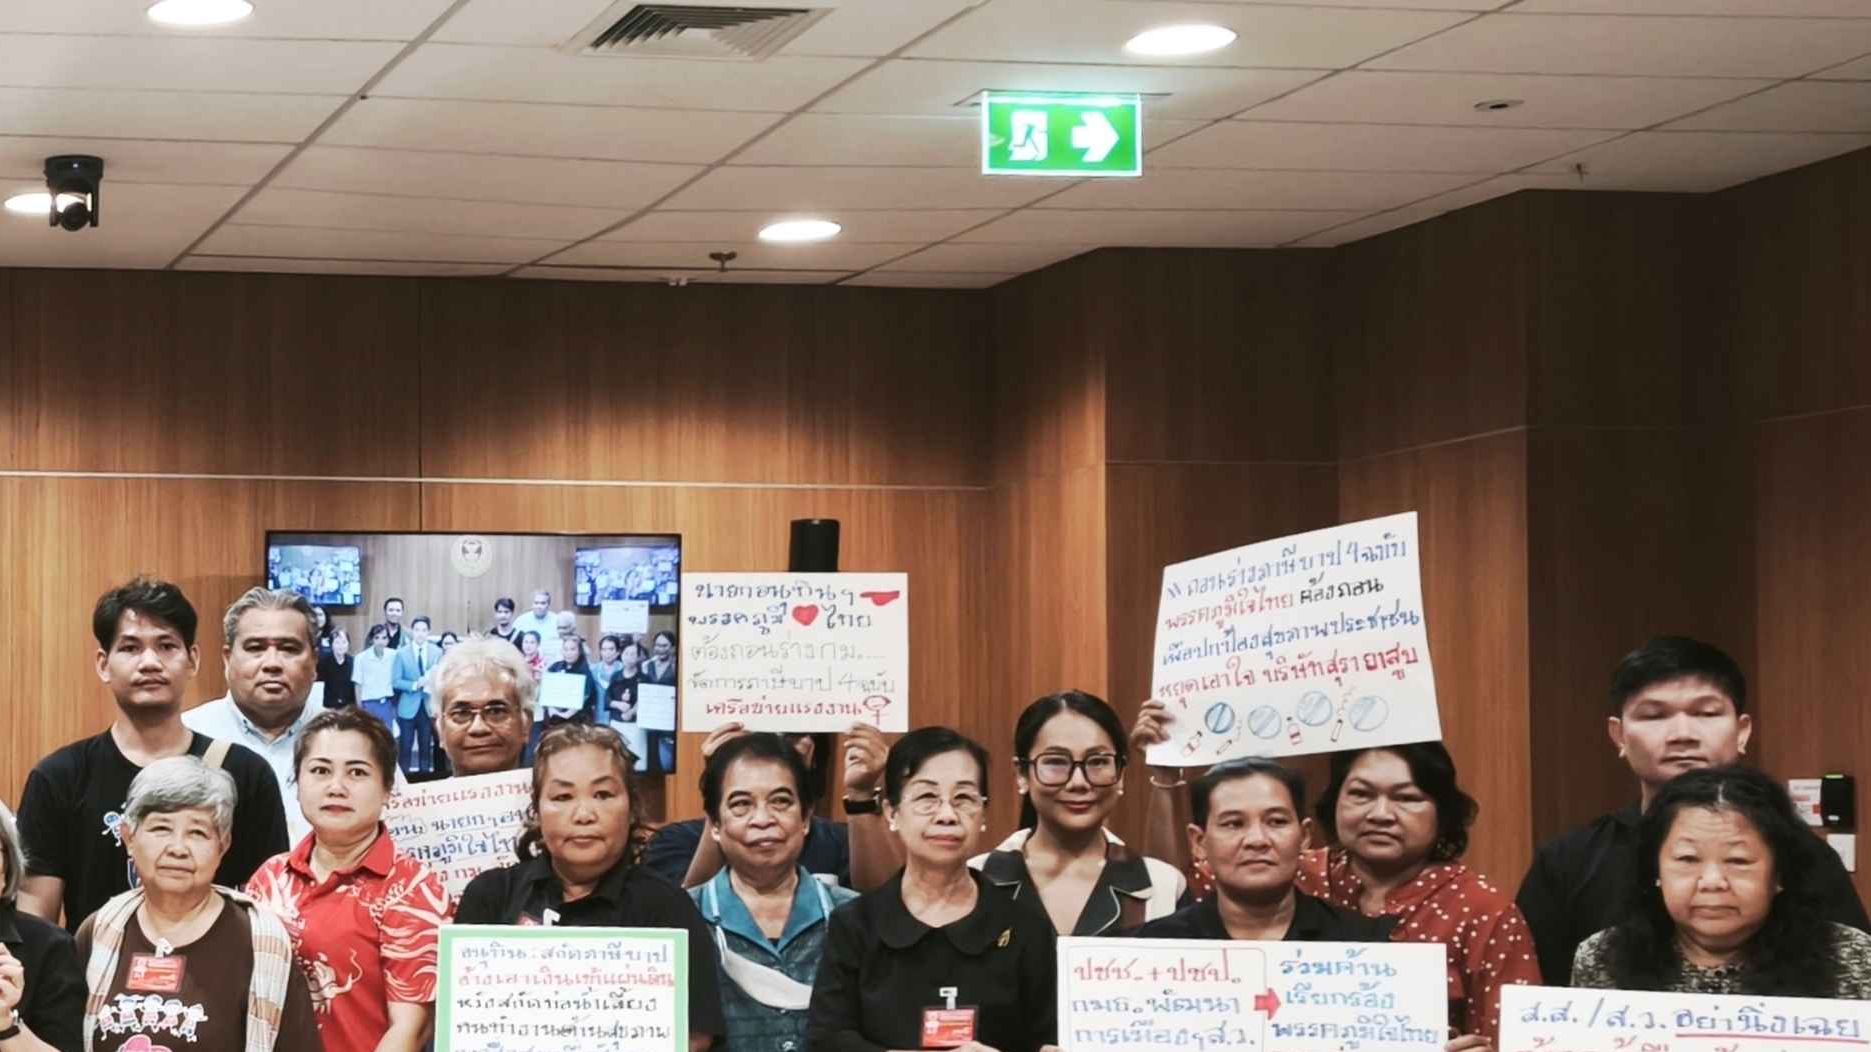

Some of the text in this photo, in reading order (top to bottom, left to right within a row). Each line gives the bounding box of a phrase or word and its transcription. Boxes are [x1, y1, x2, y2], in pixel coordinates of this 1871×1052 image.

[1286, 982, 1395, 1009] เรียกร้อง
[1272, 1014, 1439, 1050] พรรคภูมิใจไทย
